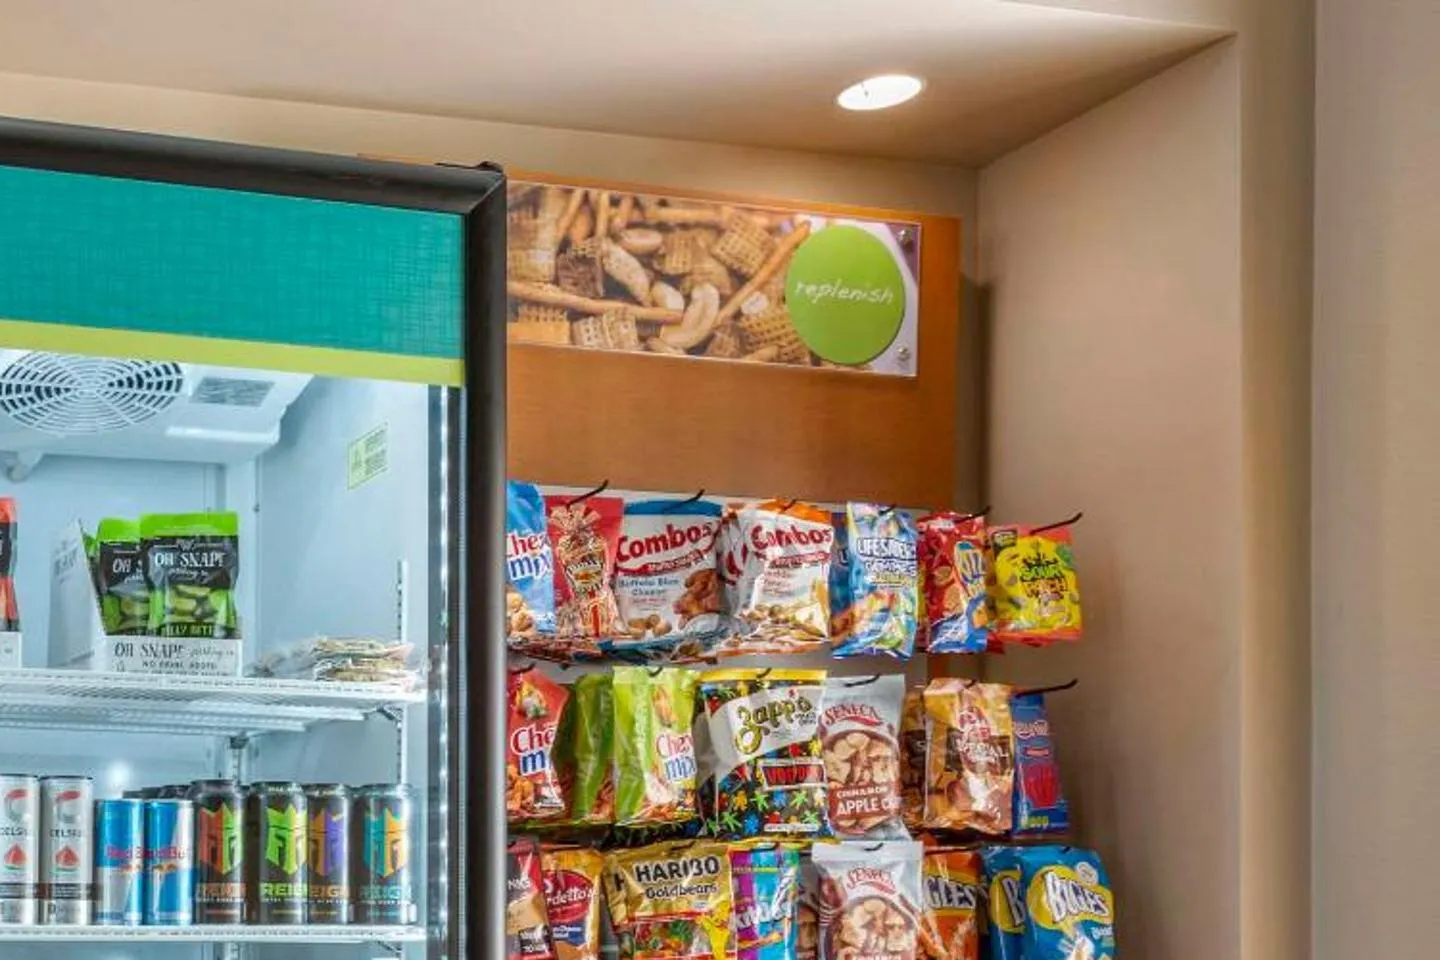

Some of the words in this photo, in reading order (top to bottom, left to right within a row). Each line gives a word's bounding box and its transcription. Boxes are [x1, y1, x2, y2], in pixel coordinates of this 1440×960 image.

[793, 278, 895, 307] replenish
[616, 522, 713, 562] Combos
[750, 524, 832, 551] Combos
[825, 703, 880, 725] SENECA
[512, 723, 557, 754] Che
[837, 797, 880, 816] APPLE
[635, 855, 721, 884] HARIBO
[645, 882, 718, 900] Goldbears
